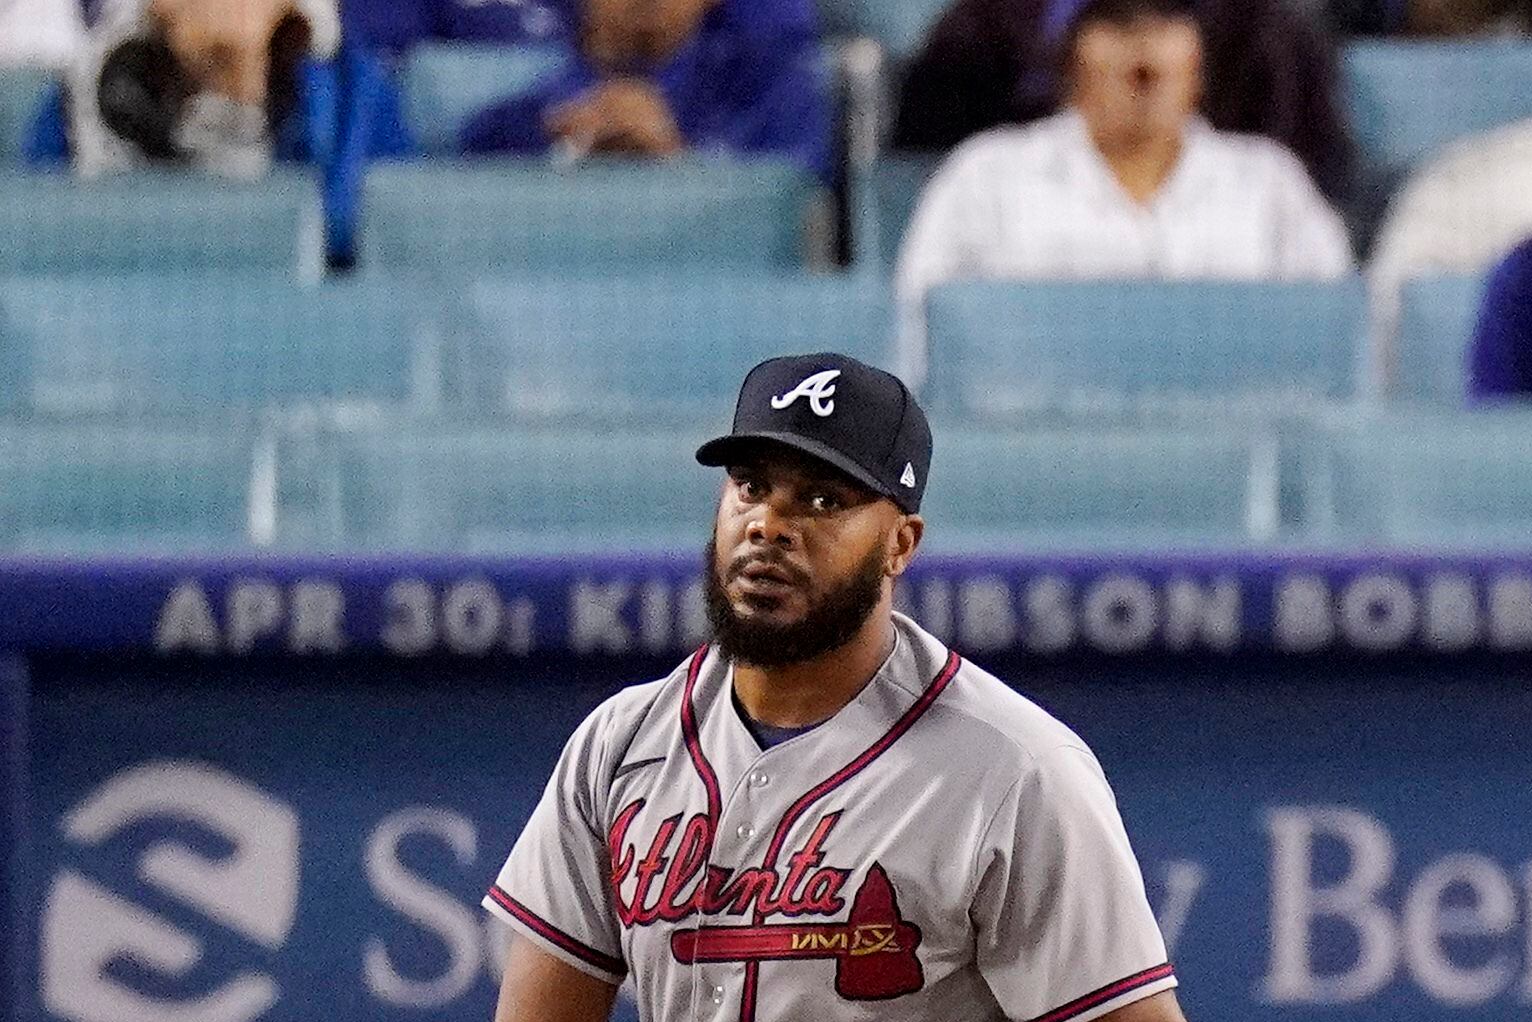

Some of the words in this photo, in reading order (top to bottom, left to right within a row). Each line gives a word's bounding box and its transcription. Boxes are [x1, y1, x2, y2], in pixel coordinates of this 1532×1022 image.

[771, 369, 841, 417] A
[155, 576, 348, 653] APR
[380, 576, 534, 654] 30:
[897, 575, 1245, 652] IBSON
[607, 797, 854, 929] Atlanta
